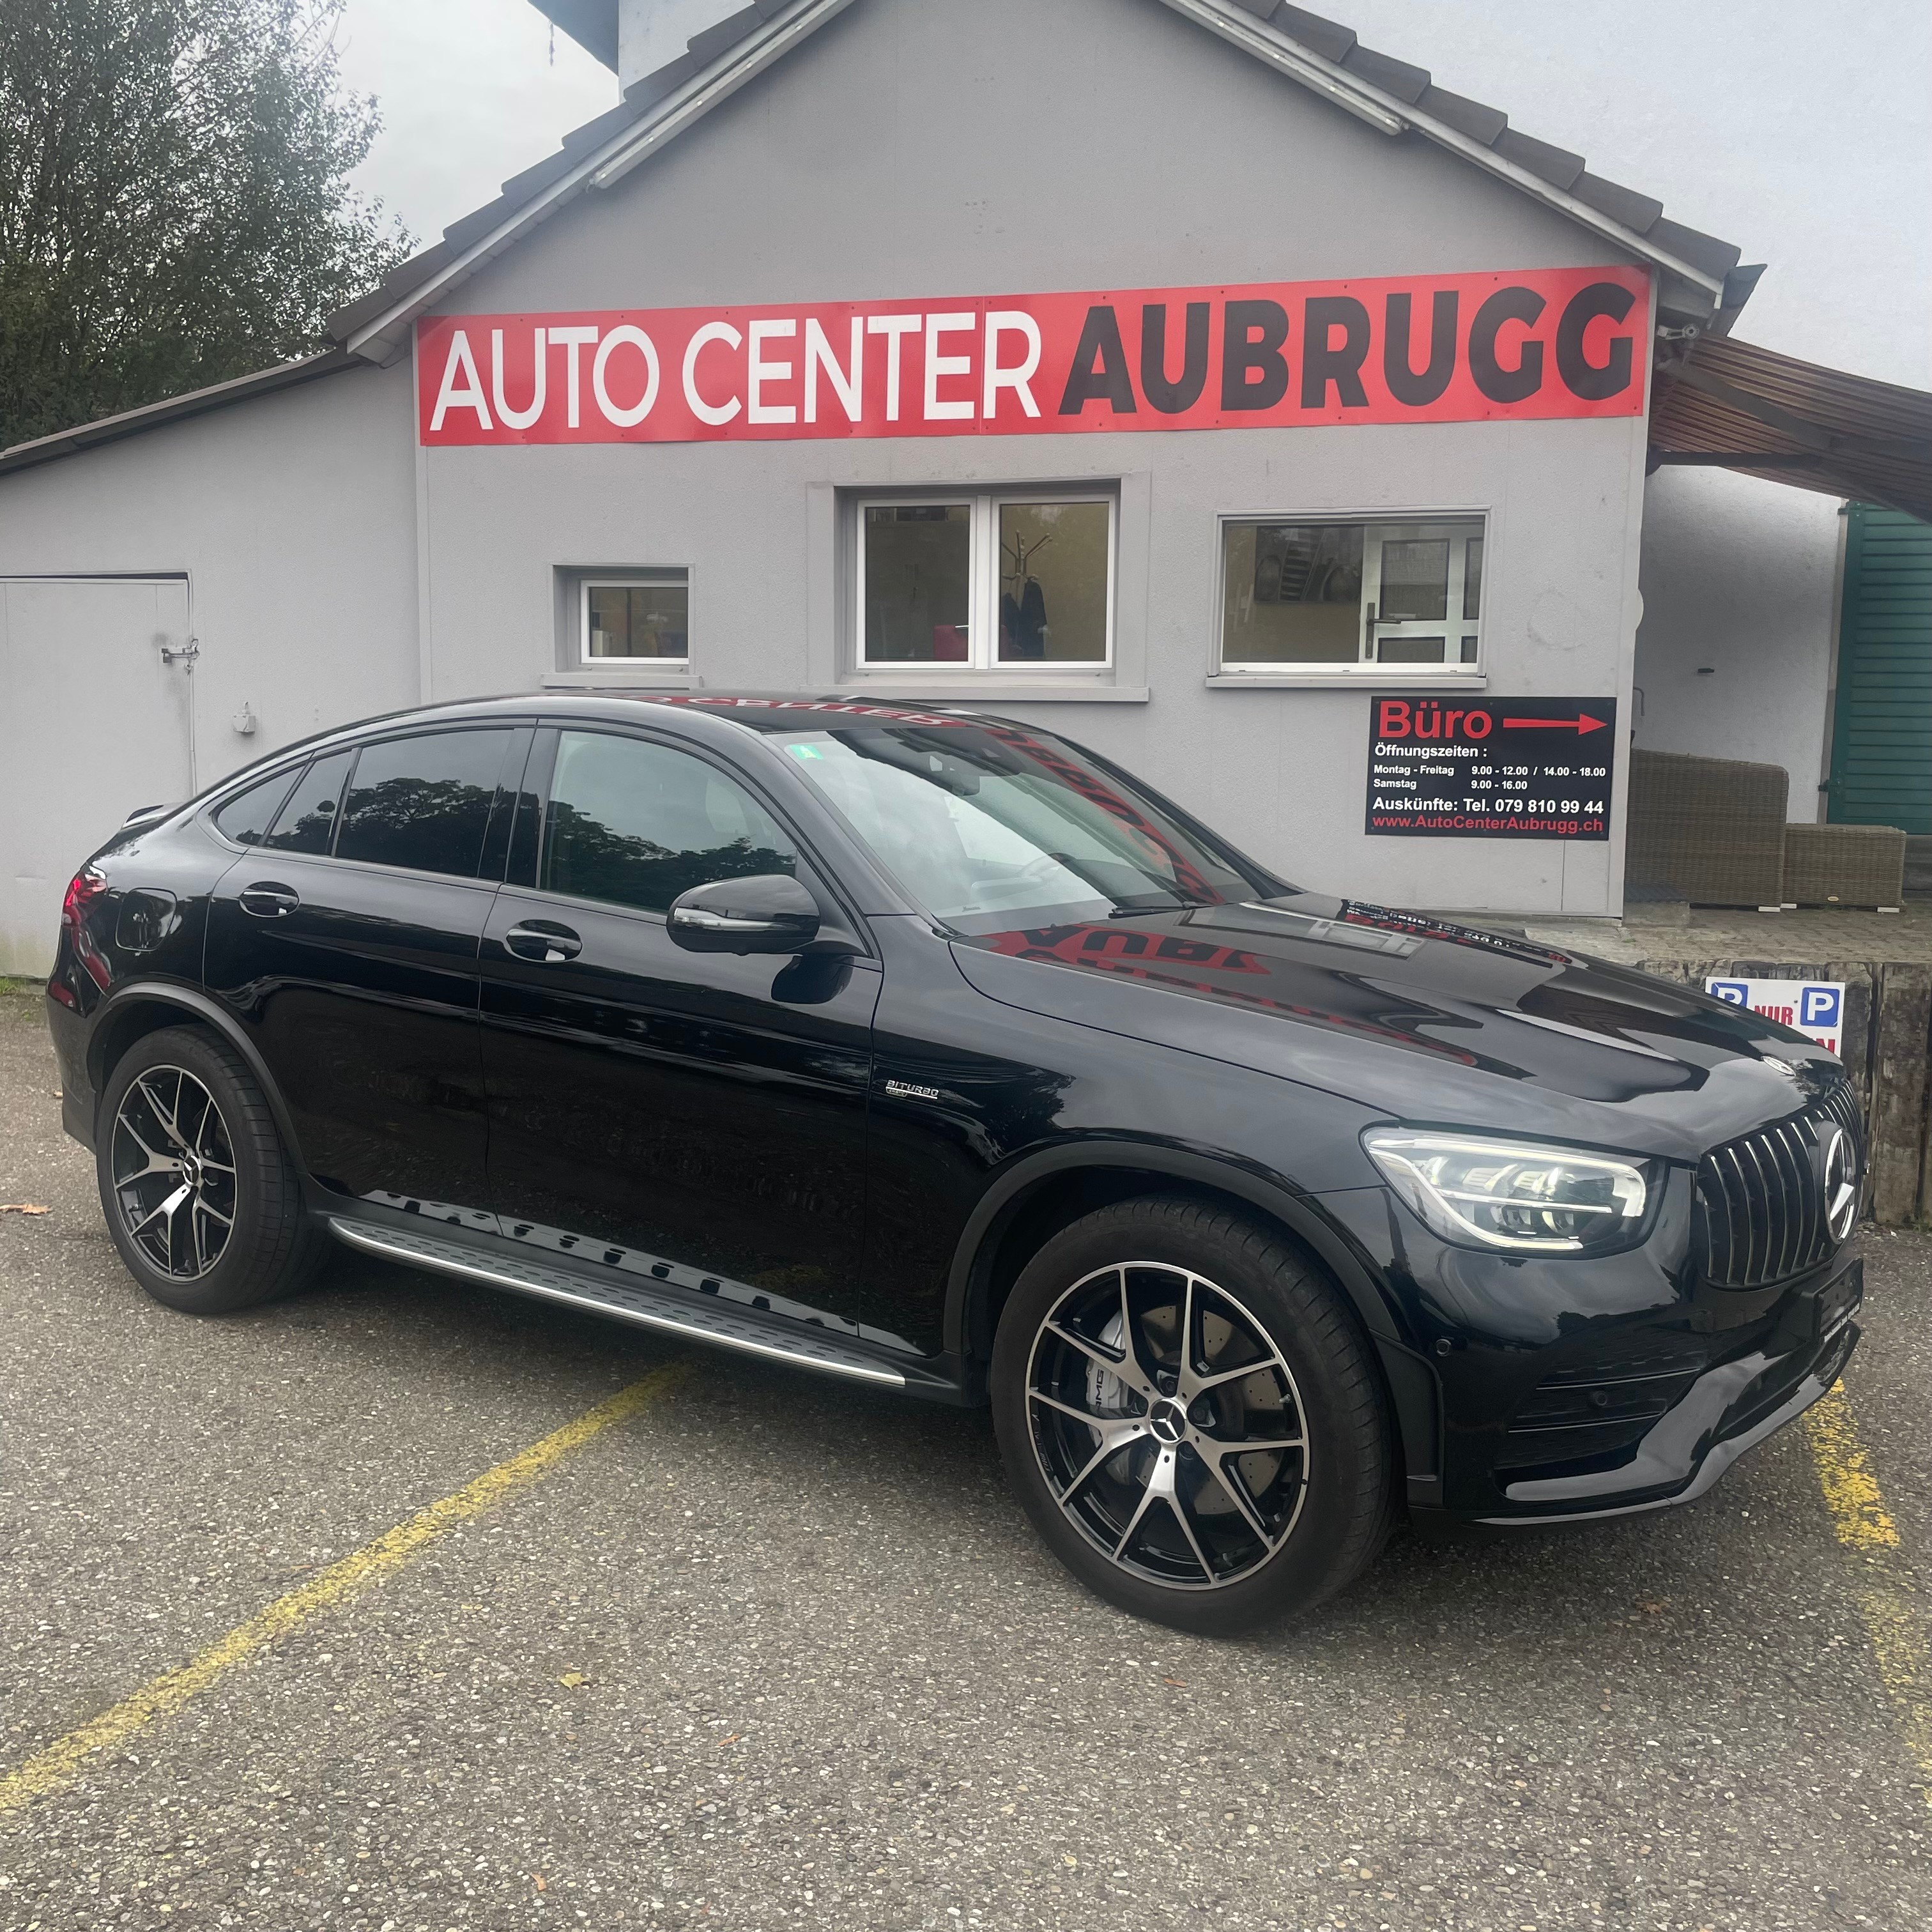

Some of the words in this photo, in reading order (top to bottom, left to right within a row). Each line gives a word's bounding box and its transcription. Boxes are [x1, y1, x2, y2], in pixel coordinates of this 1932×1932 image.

[429, 325, 659, 431] AUTO
[682, 310, 1041, 425] CENTER
[1057, 282, 1636, 415] AUBRUGG
[1379, 701, 1492, 739] Büro
[1375, 742, 1478, 759] Öffnungszeiten
[1374, 765, 1410, 776] Montag
[1420, 765, 1455, 776] Freitag
[1471, 766, 1492, 775] 9.00
[1502, 766, 1528, 776] 12.00
[1533, 766, 1538, 776] /
[1544, 767, 1570, 776] 14.00
[1579, 767, 1606, 776] 18.00
[1374, 779, 1417, 790] Samstag
[1471, 780, 1492, 789] 9.00
[1501, 781, 1528, 790] 16.00
[1372, 797, 1458, 811] Auskünfte:
[1463, 798, 1490, 811] Tel.
[1495, 799, 1523, 812] 079
[1528, 799, 1556, 813] 810
[1561, 800, 1579, 813] 99
[1584, 801, 1604, 814] 44
[1372, 815, 1603, 834] www.AutoCenterAubrugg.ch
[1807, 992, 1834, 1021] P
[886, 1080, 939, 1096] BITURBO
